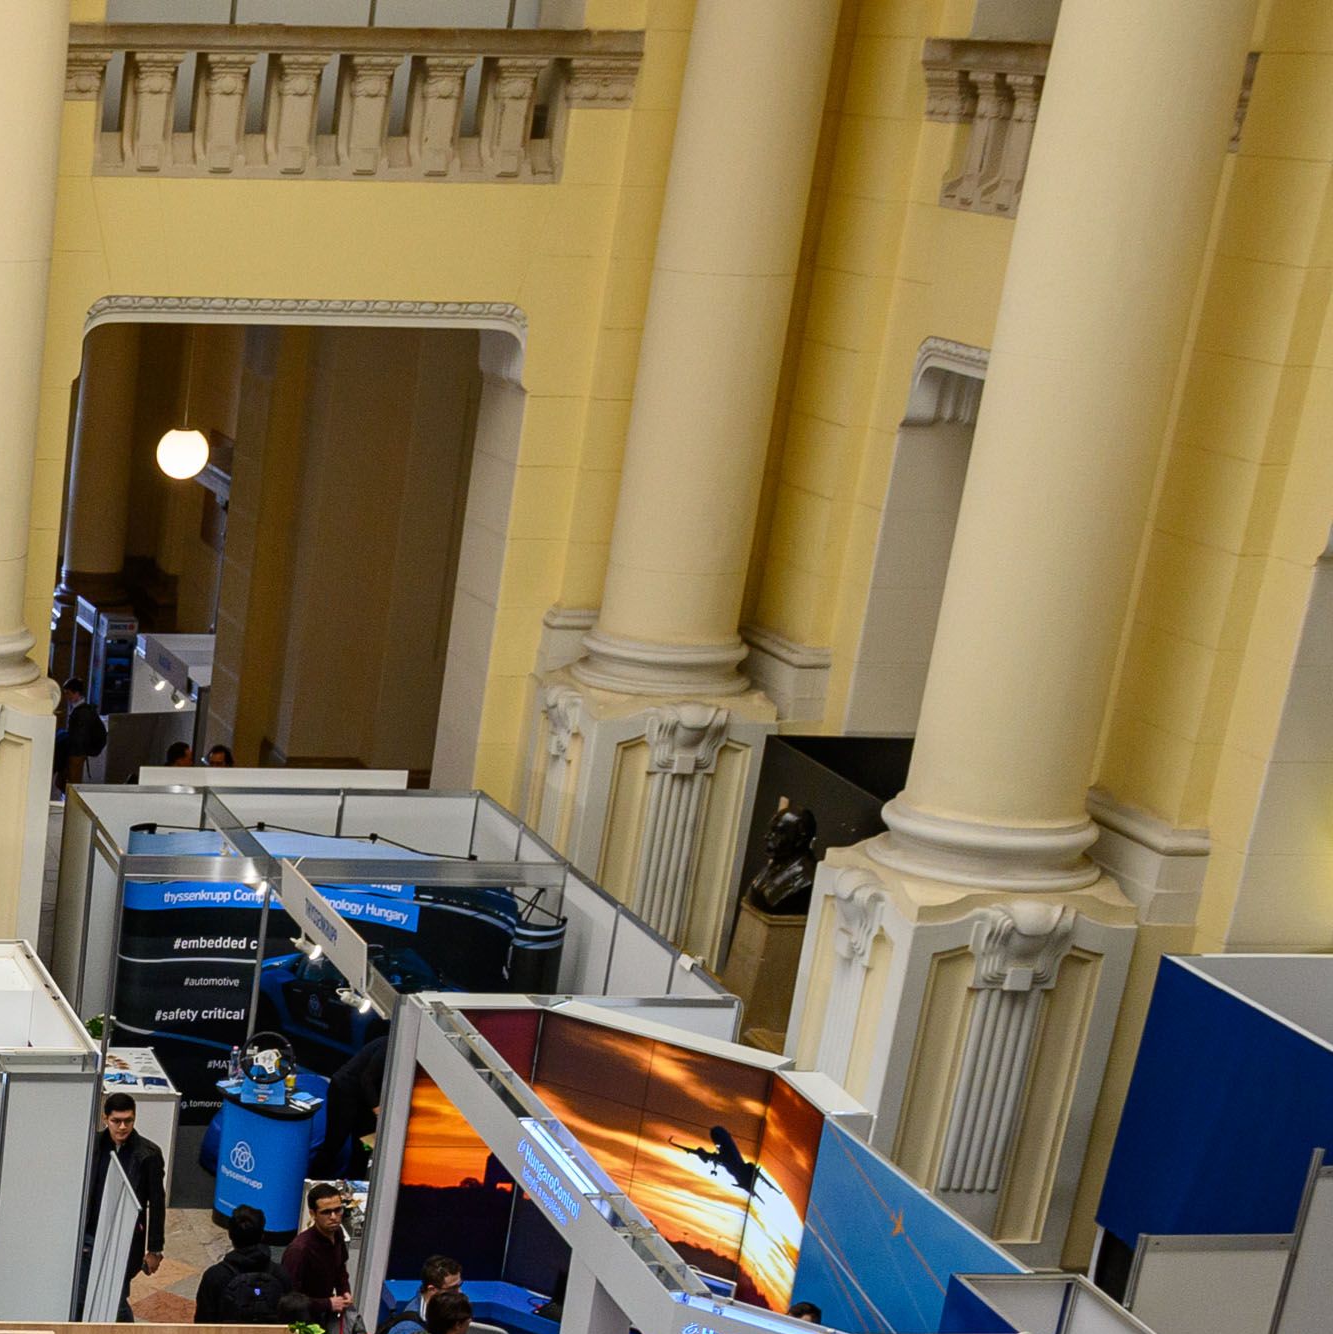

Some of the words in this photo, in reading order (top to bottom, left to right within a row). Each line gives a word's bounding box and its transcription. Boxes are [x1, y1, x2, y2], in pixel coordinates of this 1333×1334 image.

[164, 891, 231, 904] thyssenkrupp
[365, 902, 409, 925] Hungary
[174, 937, 246, 950] #embedded
[184, 976, 239, 987] #automotive
[155, 1008, 199, 1023] #safety
[201, 1007, 245, 1021] critical
